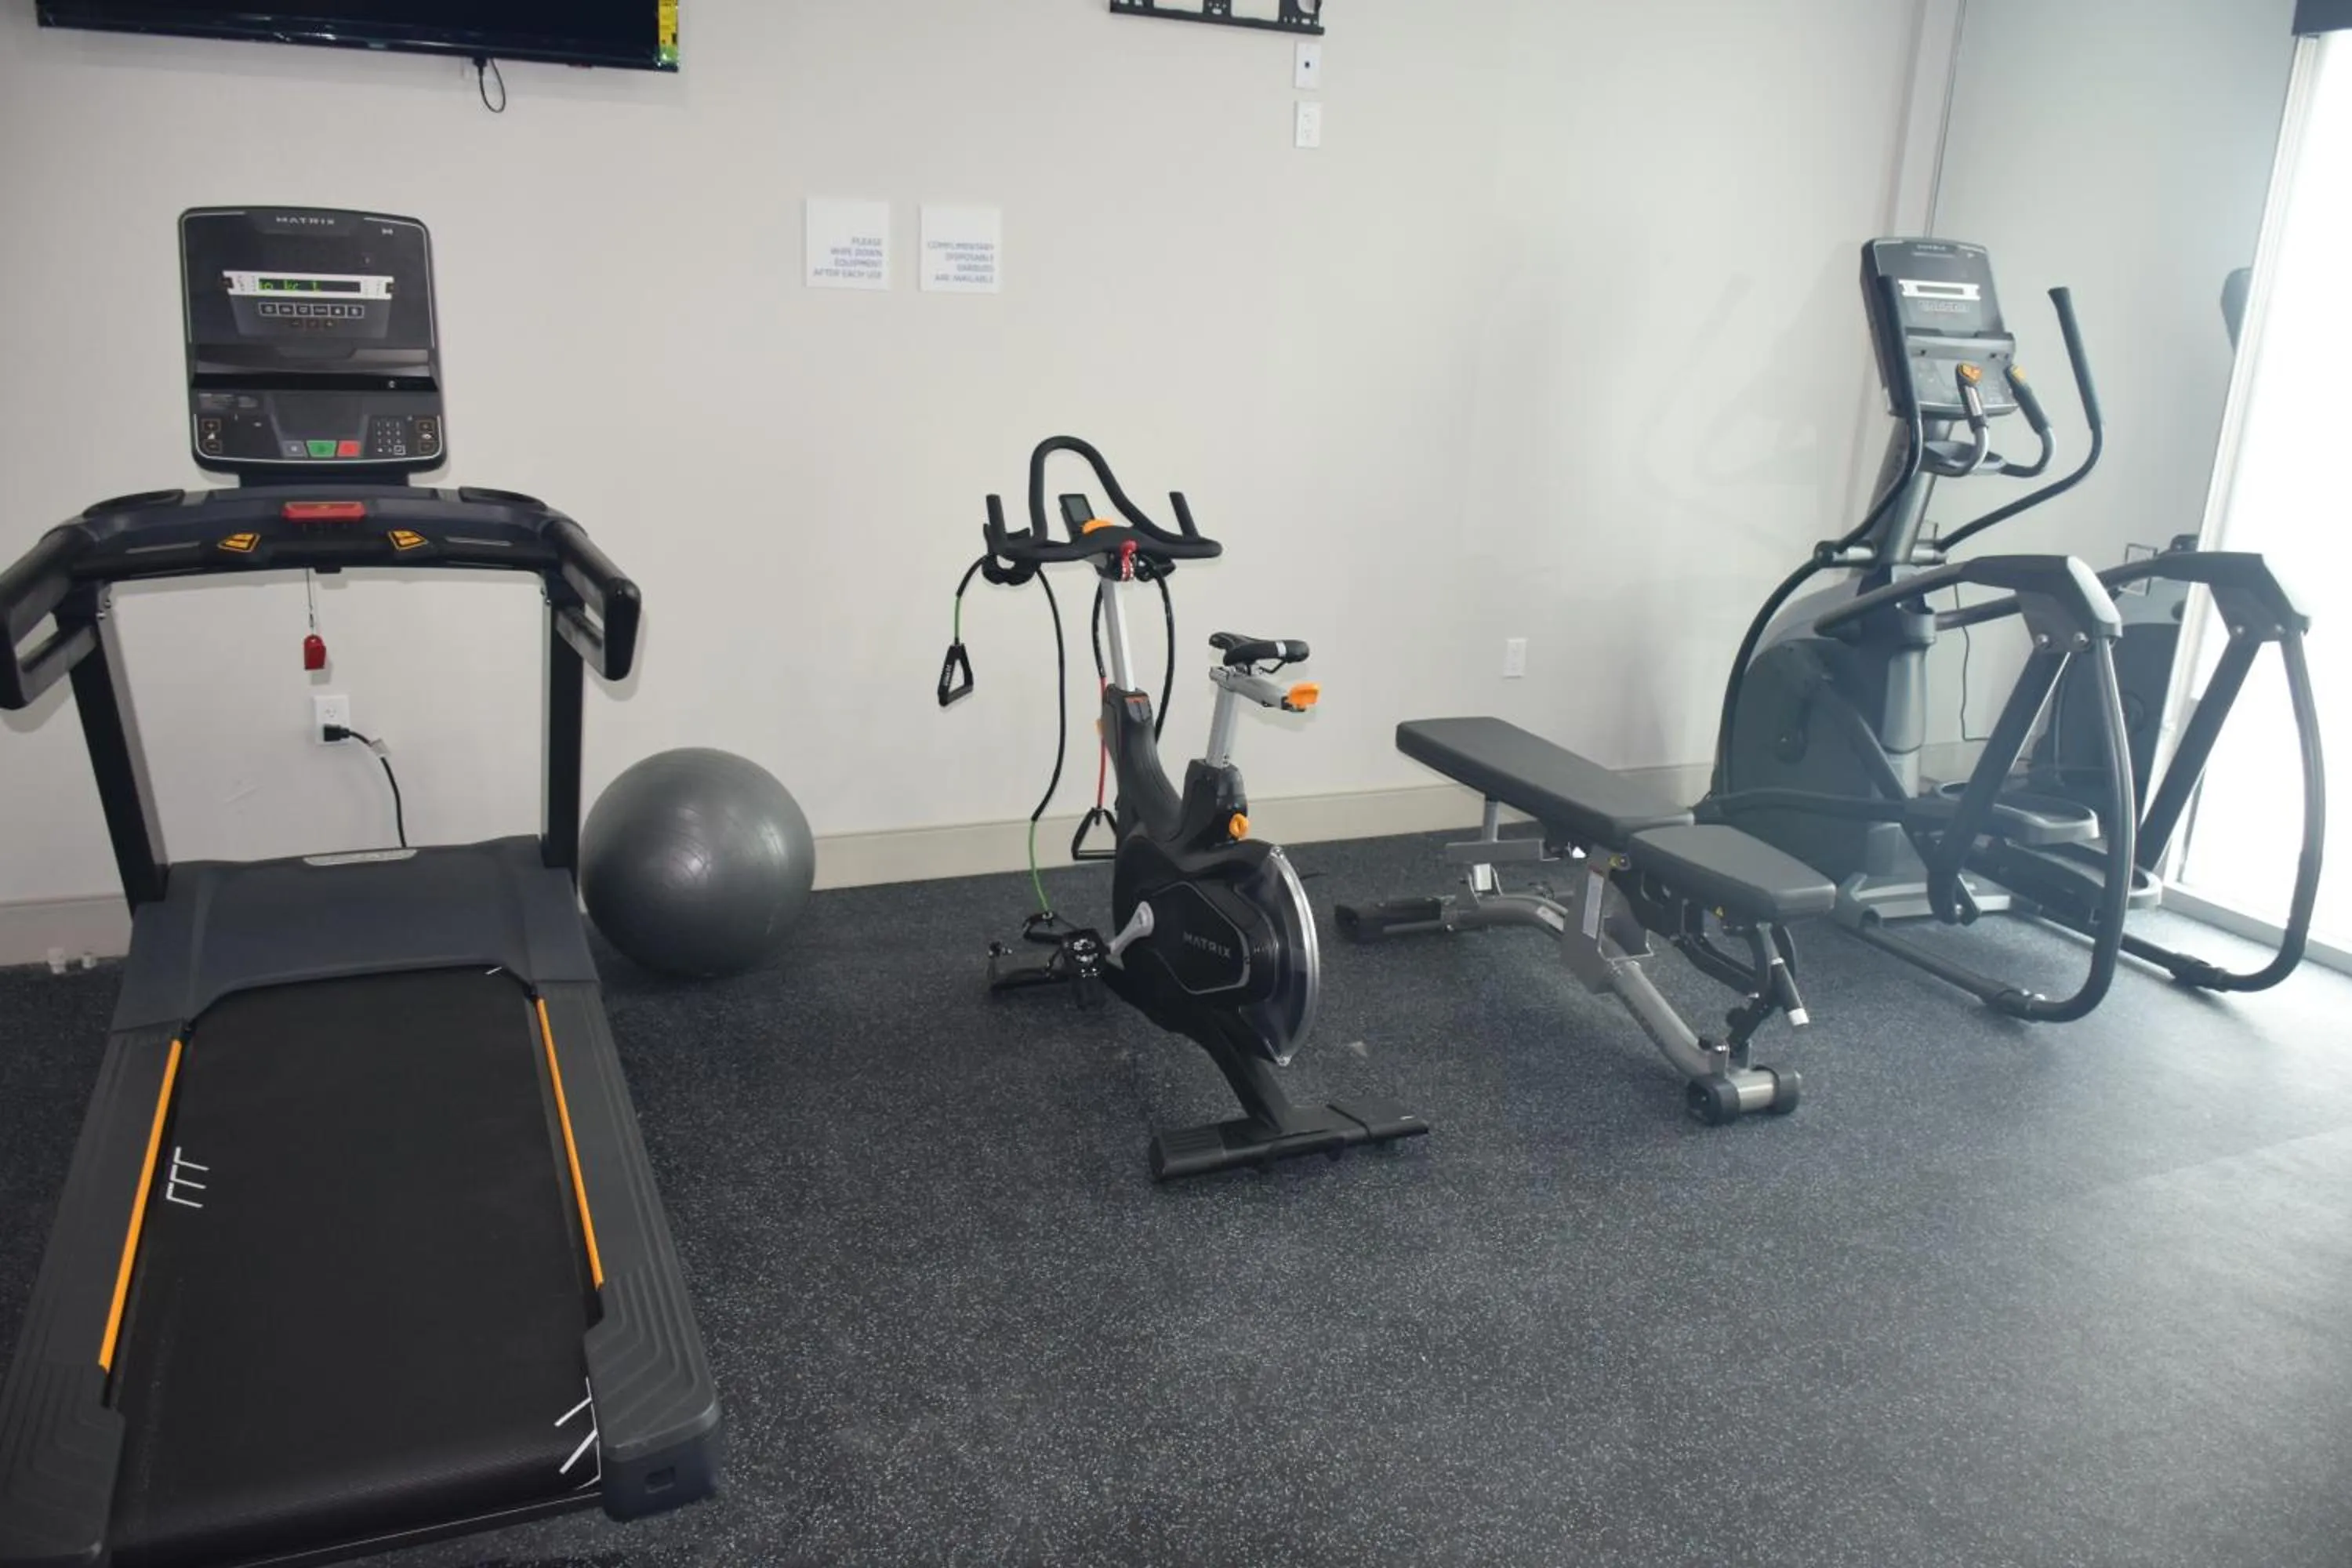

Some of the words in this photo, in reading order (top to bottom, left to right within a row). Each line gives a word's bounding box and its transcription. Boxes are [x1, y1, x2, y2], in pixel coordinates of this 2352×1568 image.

[276, 216, 335, 225] MATRIX
[851, 237, 882, 246] PLEASE
[814, 268, 840, 277] AFTER
[843, 270, 865, 278] EACH
[1182, 931, 1231, 958] MATRIX
